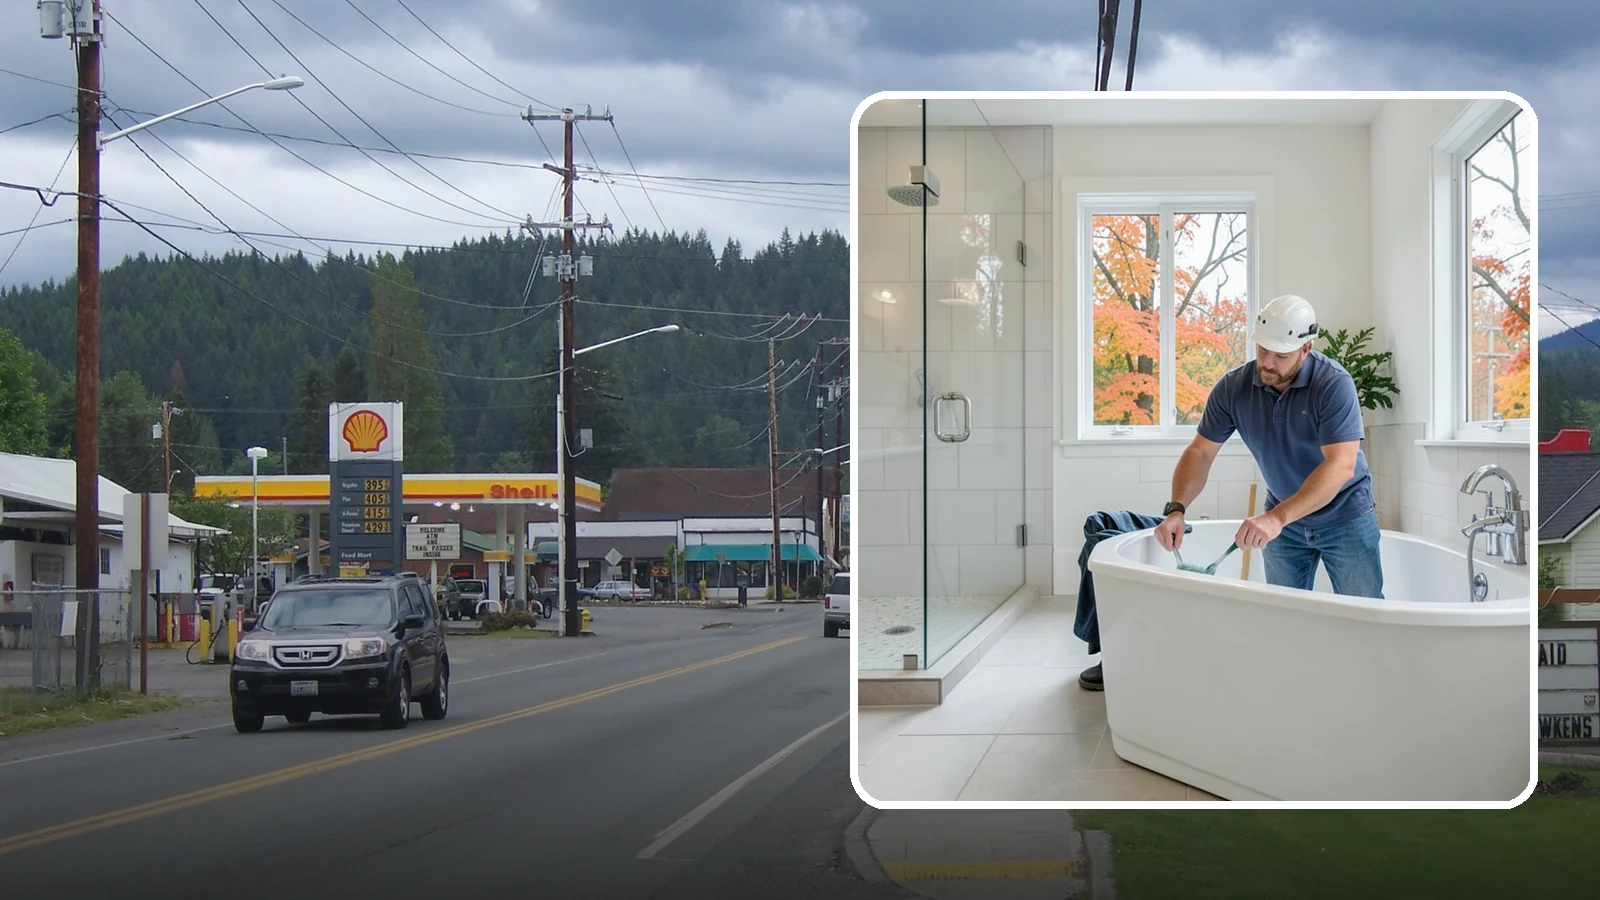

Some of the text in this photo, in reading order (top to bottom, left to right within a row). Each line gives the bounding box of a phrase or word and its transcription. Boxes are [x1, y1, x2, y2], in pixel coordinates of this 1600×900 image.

[366, 479, 383, 490] 395
[490, 484, 547, 499] Shell
[366, 494, 383, 504] 405
[366, 508, 383, 518] 415
[366, 522, 383, 532] 429
